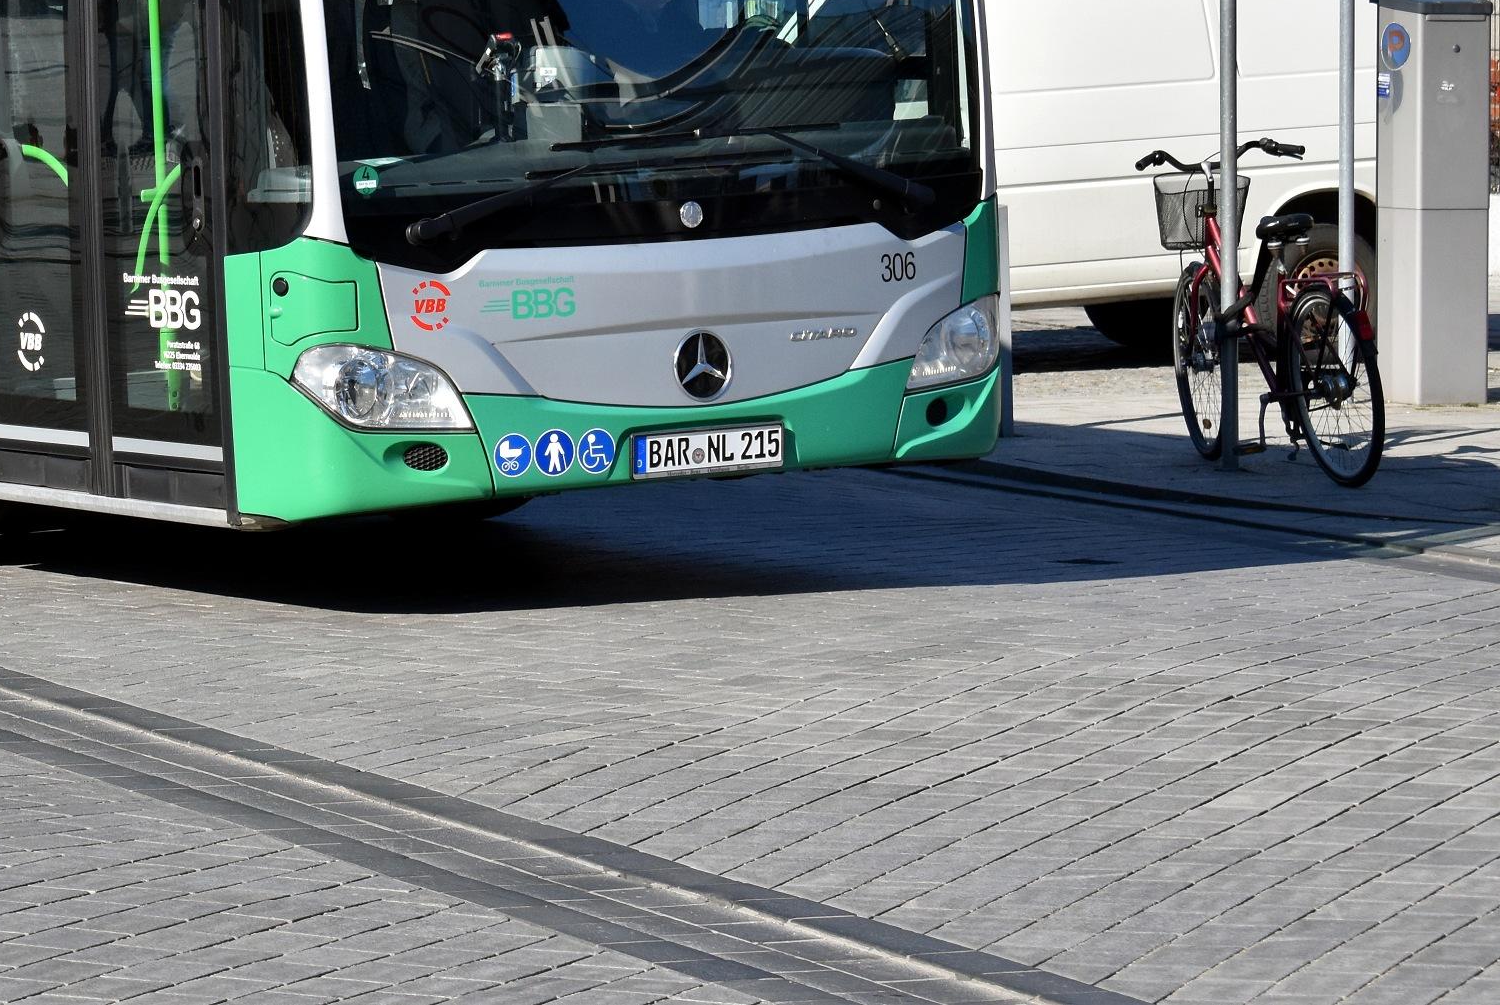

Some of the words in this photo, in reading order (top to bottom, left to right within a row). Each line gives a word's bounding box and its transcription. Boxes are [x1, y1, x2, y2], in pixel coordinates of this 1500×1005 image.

[123, 272, 151, 285] Barnimer
[151, 273, 200, 287] Busgesellschaft
[881, 252, 916, 283] 306
[149, 289, 201, 331] BBG
[414, 298, 446, 314] VBB
[511, 287, 576, 320] BBG
[20, 332, 42, 351] VBB
[649, 437, 690, 469] BAR
[707, 434, 735, 464] NL
[741, 429, 780, 461] 215
